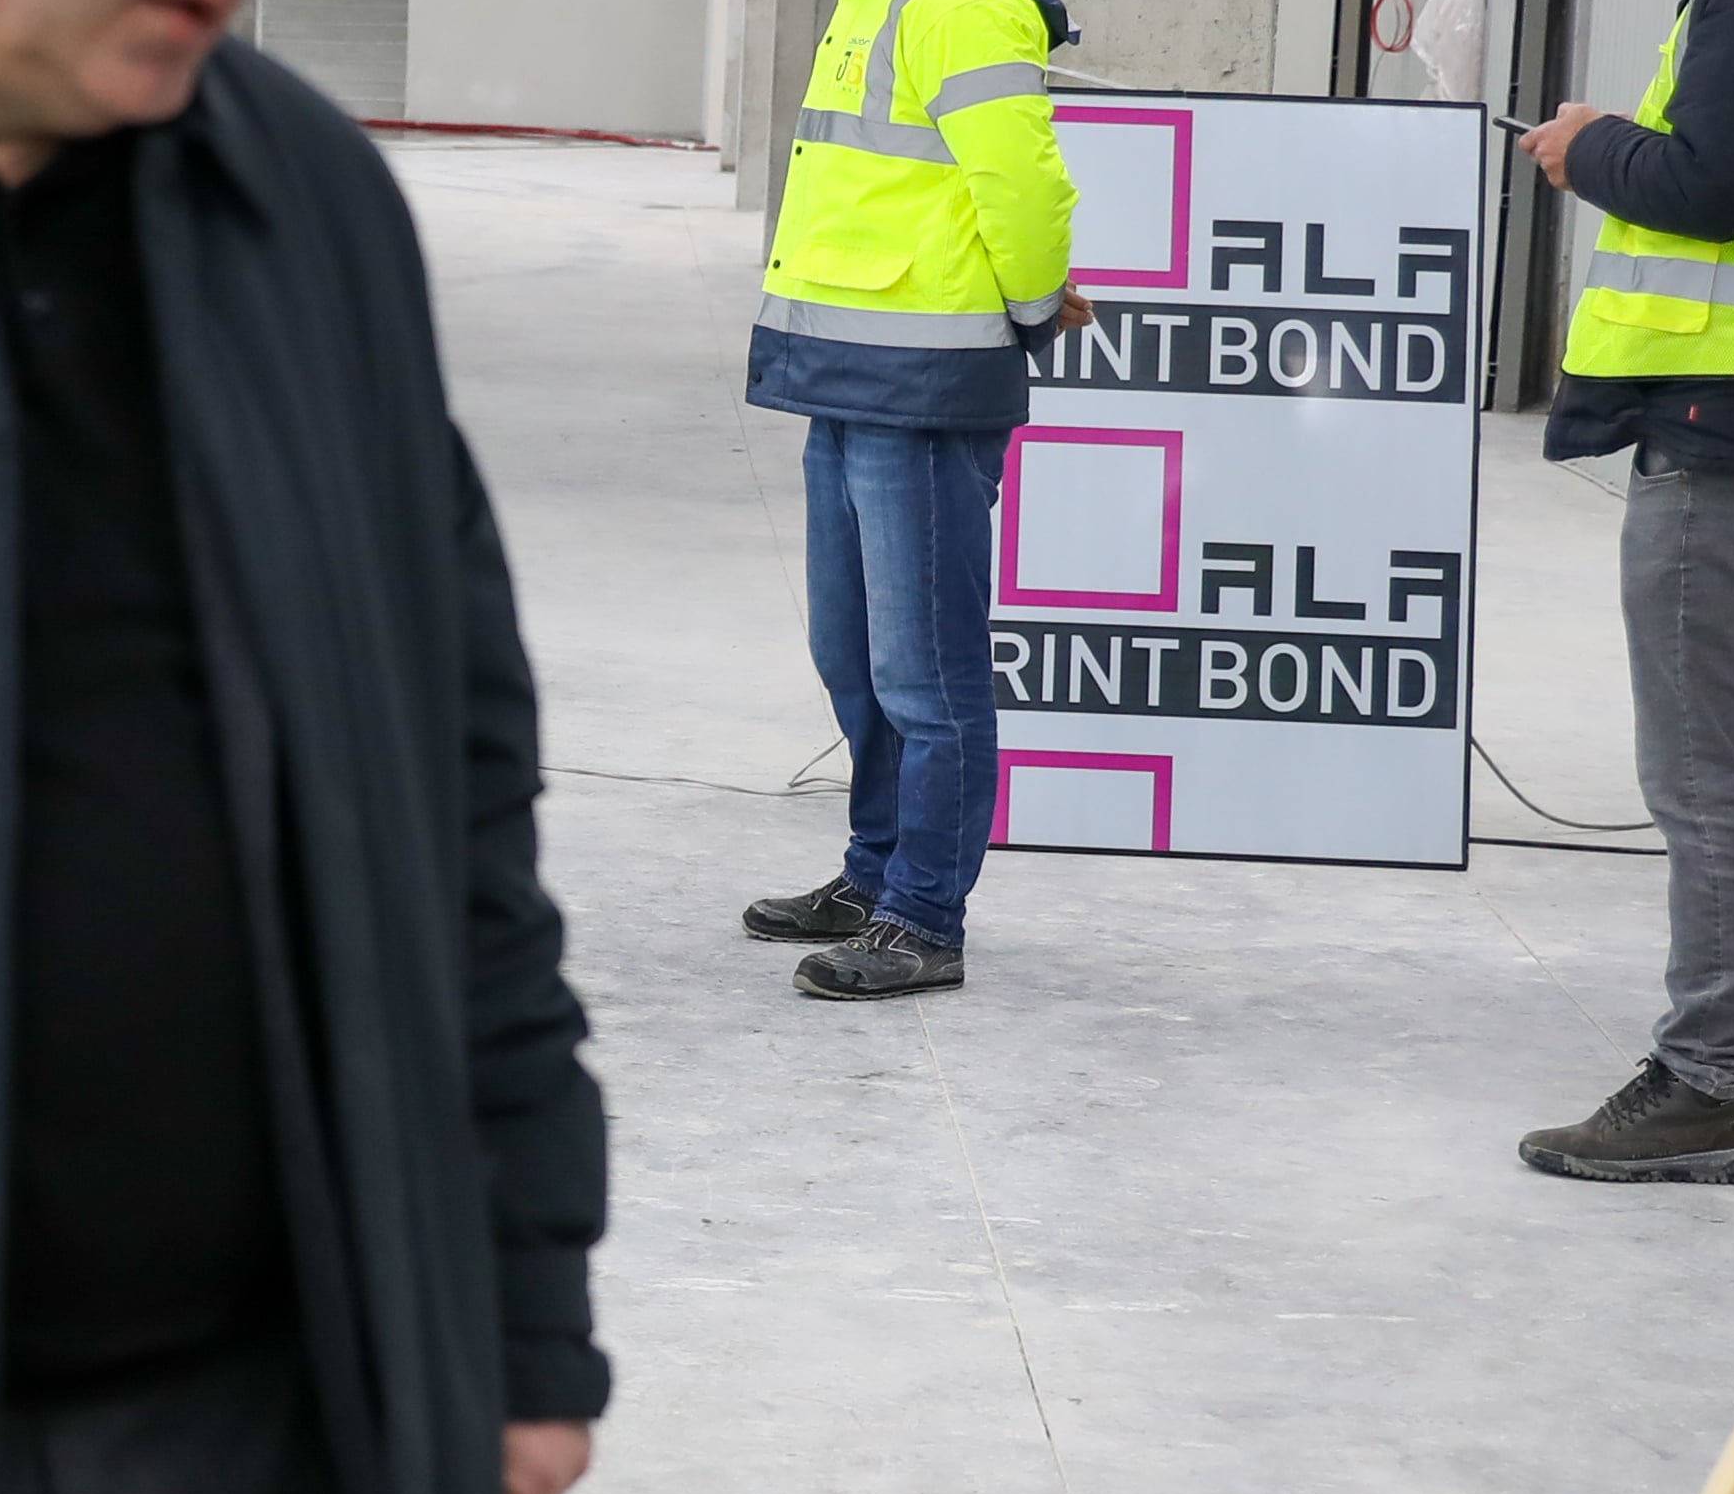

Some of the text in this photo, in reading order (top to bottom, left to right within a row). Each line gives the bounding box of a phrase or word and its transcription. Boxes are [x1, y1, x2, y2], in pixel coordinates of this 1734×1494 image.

[1211, 220, 1469, 298] ALA
[1026, 313, 1445, 393] INT BOND
[1201, 542, 1461, 622] ALA
[1199, 640, 1436, 718] BOND
